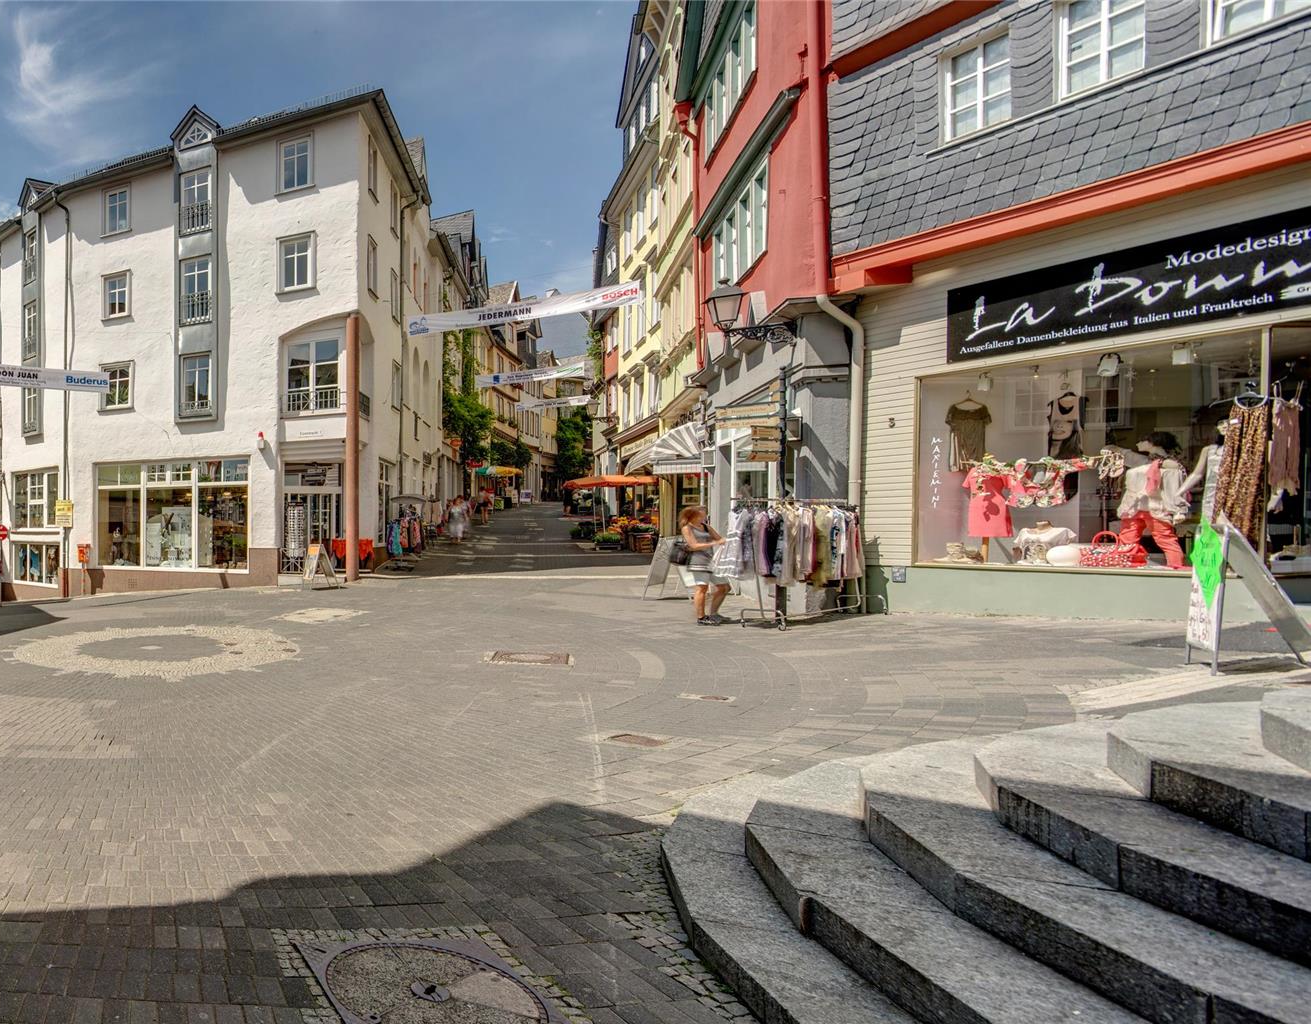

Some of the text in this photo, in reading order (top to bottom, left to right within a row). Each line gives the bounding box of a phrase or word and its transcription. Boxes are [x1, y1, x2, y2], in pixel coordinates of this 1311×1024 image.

[601, 288, 639, 302] BOSCH
[477, 306, 532, 322] JEDERMANN
[965, 296, 1056, 341] La
[959, 292, 1273, 355] Ausgefallene Damenbekleidung aus Italien und Frankreich
[17, 371, 39, 380] JUAN
[65, 375, 108, 386] Buderus
